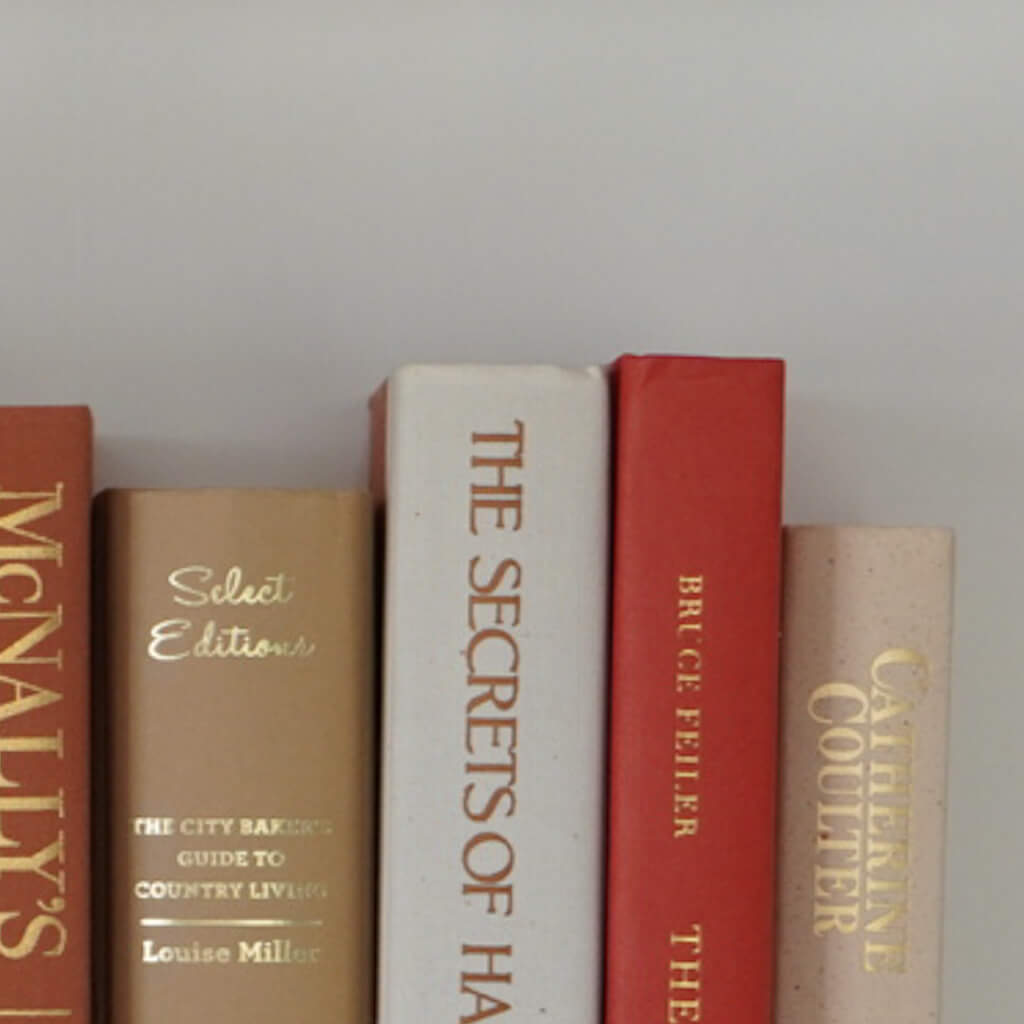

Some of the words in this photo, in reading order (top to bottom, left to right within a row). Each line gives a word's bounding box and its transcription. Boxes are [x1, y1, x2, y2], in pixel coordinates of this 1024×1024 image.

[469, 418, 525, 536] THE
[167, 565, 296, 607] Select
[147, 617, 317, 661] Editions
[676, 574, 704, 693] BRUCE
[461, 554, 522, 823] SECRETS
[673, 708, 701, 839] FEILER
[807, 682, 869, 938] COULTER
[864, 648, 931, 974] CATHERINE
[133, 817, 174, 836] THE
[179, 818, 234, 836] CITY
[176, 850, 249, 868] GUIDE
[253, 850, 286, 868] TO
[133, 881, 244, 899] COUNTRY
[249, 881, 328, 899] LIVING
[461, 831, 515, 918] OF
[142, 940, 231, 964] Louise
[237, 939, 321, 964] Miller
